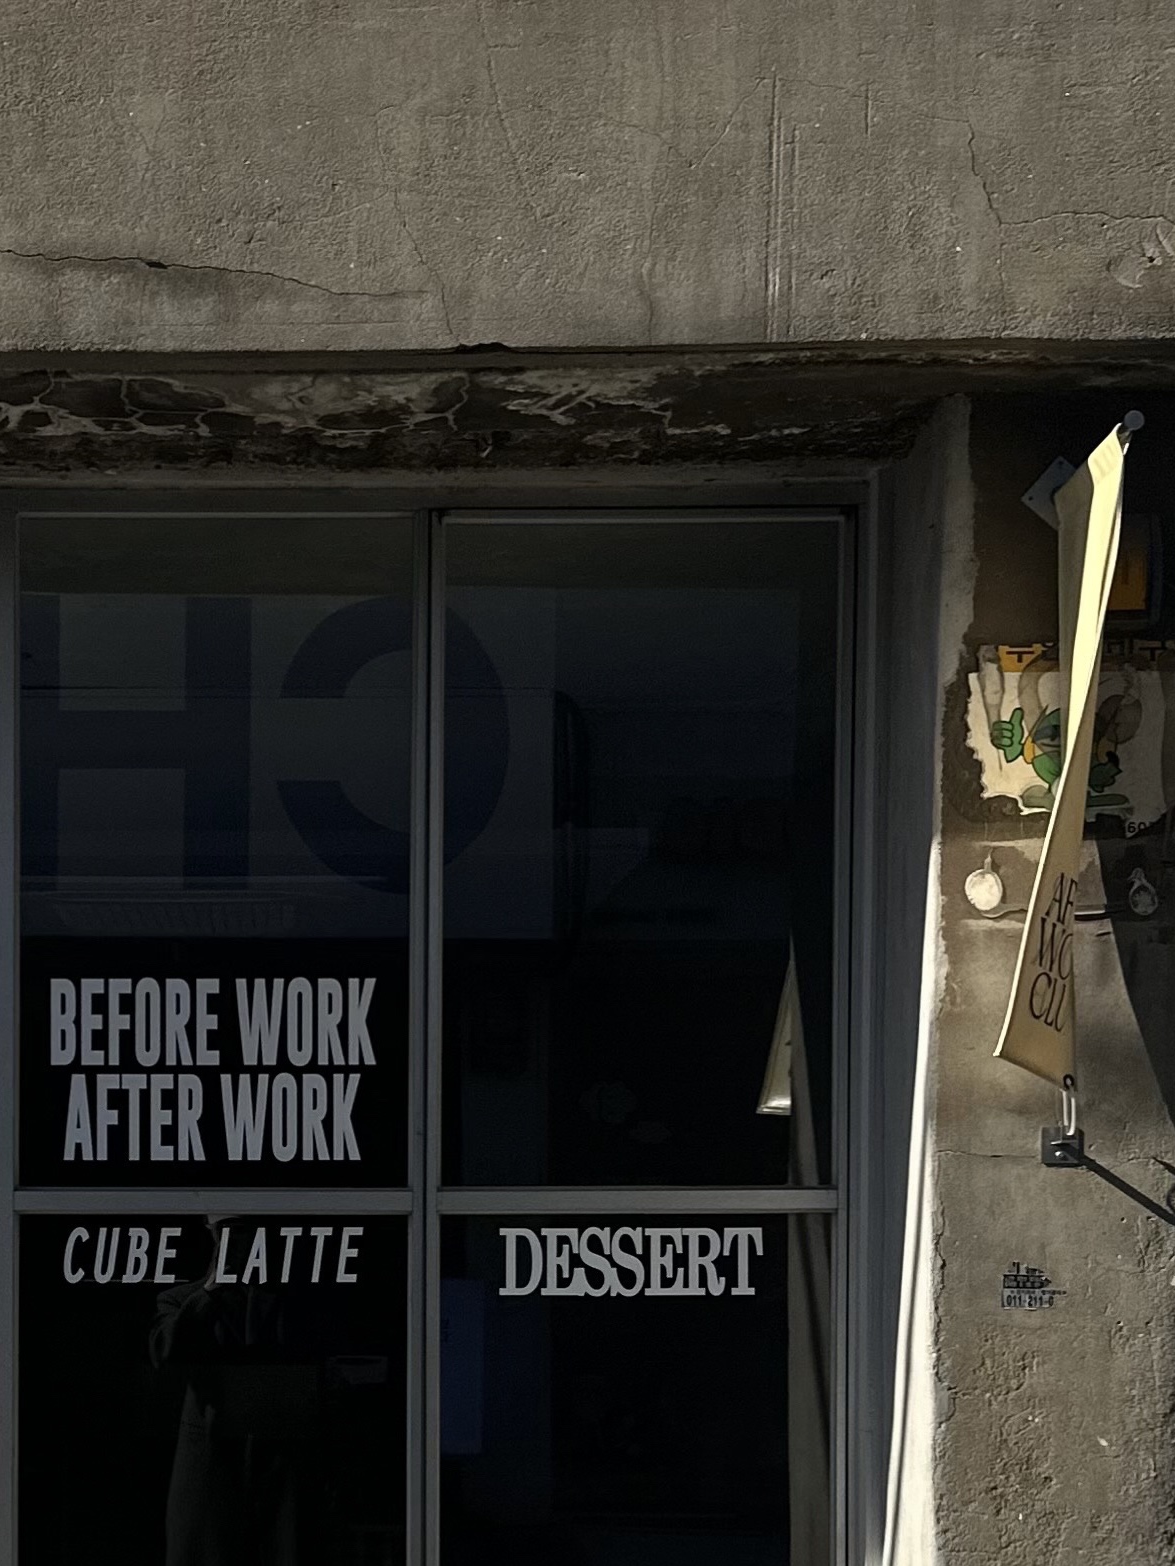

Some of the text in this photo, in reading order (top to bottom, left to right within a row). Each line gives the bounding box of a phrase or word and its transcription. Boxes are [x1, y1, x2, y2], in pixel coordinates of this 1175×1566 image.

[50, 976, 378, 1068] BEFORE WORK
[62, 1073, 363, 1162] AFTER WORK
[63, 1227, 365, 1286] CUBE LATTE
[498, 1226, 764, 1298] DESSERT
